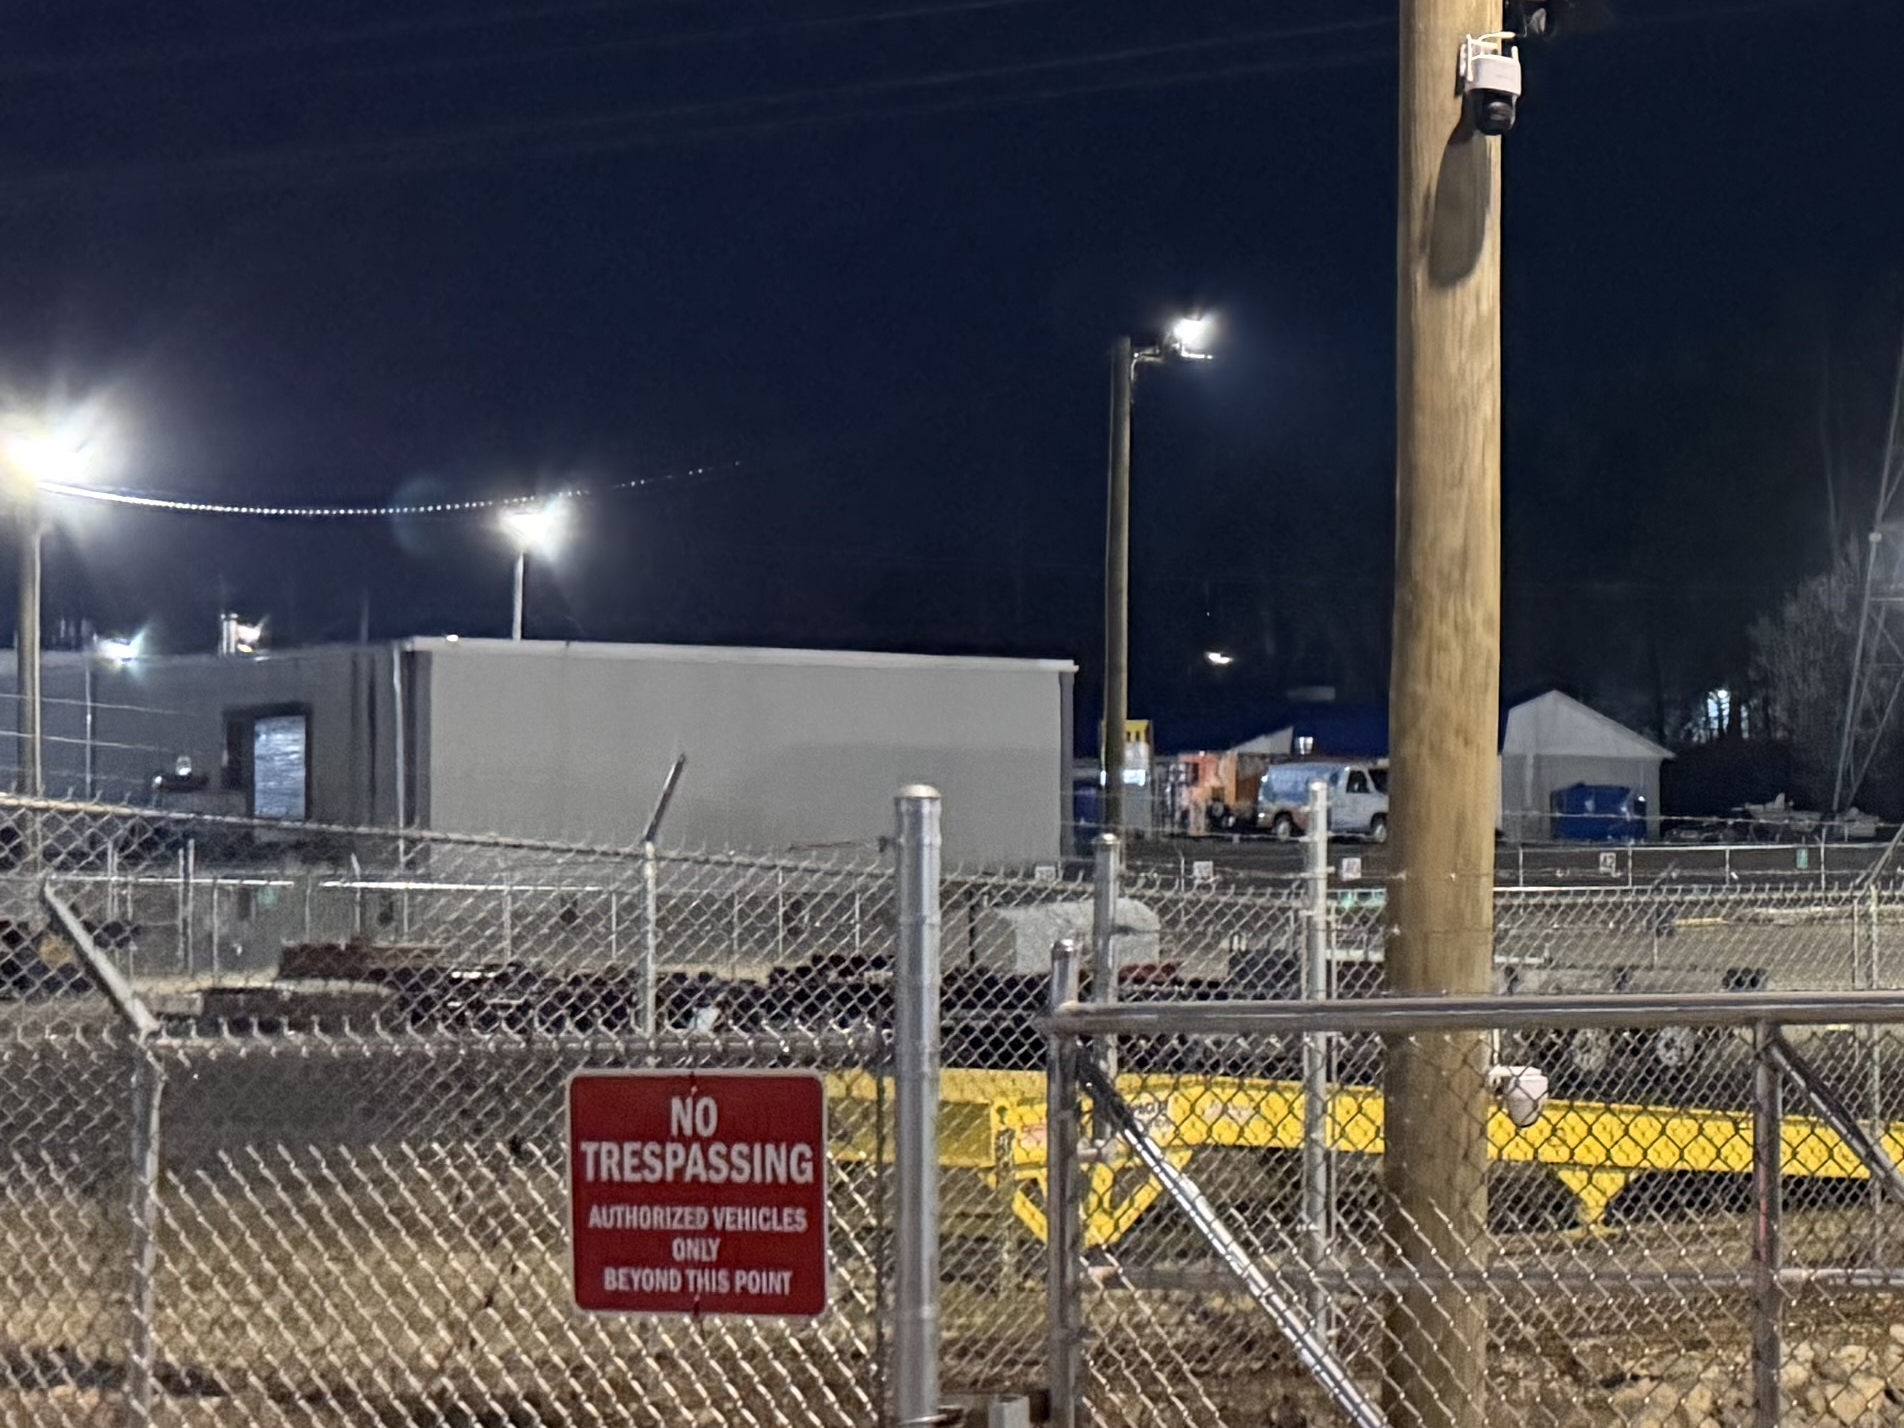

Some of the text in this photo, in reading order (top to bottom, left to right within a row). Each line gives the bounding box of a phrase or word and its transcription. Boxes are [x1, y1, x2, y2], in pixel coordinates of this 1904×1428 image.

[670, 1097, 718, 1137] NO
[581, 1141, 814, 1184] TRESPASSING
[588, 1204, 808, 1233] AUTHORIZED VEHICLES
[672, 1237, 721, 1262] ONLY
[604, 1267, 793, 1295] BEYOND THIS POINT
